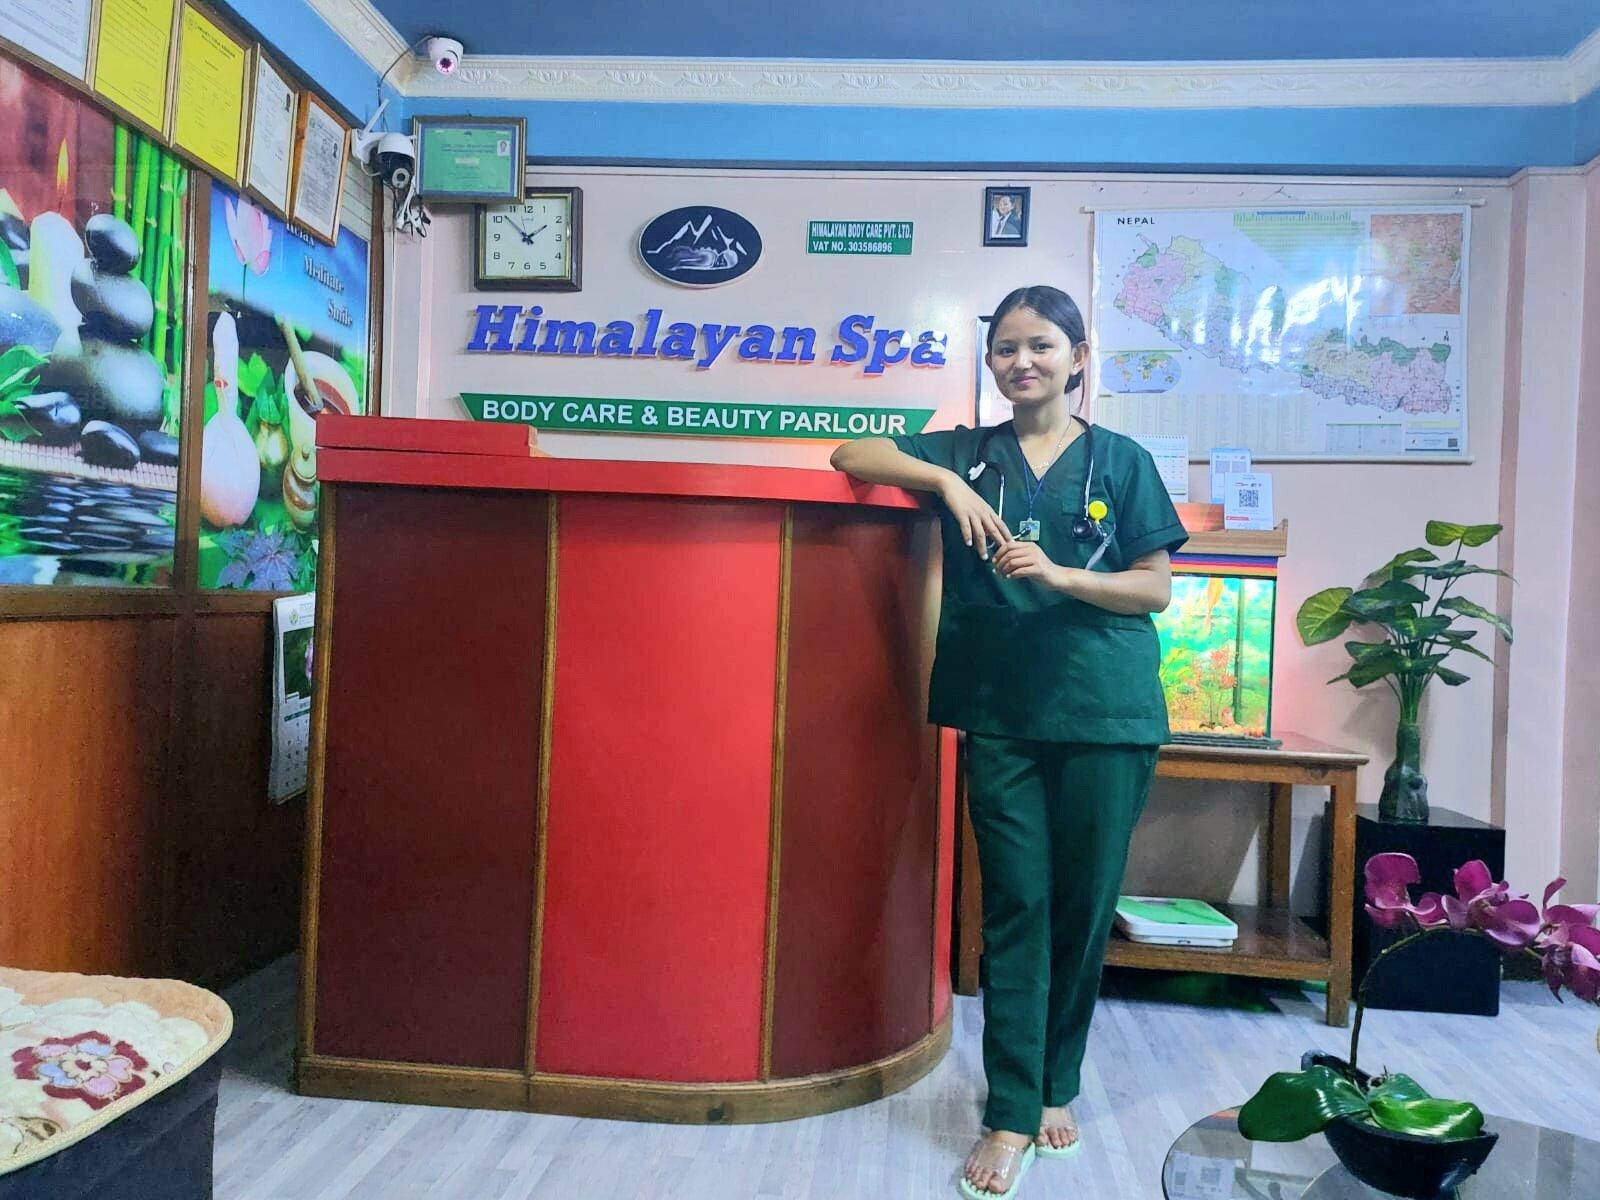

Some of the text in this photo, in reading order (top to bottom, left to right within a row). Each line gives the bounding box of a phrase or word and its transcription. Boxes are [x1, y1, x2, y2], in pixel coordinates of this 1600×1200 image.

[508, 206, 516, 214] 11
[524, 206, 534, 214] 12
[492, 216, 502, 224] 10
[556, 216, 562, 224] 2
[1117, 216, 1156, 225] NEPAL
[812, 222, 912, 239] HIMALAYAN BODY CARE PVT. LTD.
[494, 234, 500, 242] 9
[556, 234, 562, 242] 3
[812, 240, 830, 251] VAT
[831, 241, 846, 252] NO.
[493, 252, 500, 260] 8
[554, 252, 562, 260] 4
[508, 262, 516, 270] 7
[540, 262, 546, 270] 5
[304, 254, 344, 294] Meditate
[327, 298, 353, 328] Smile
[466, 304, 948, 375] Himalayan Spa
[482, 400, 906, 434] BODY CARE & BEAUTY PARLOUR
